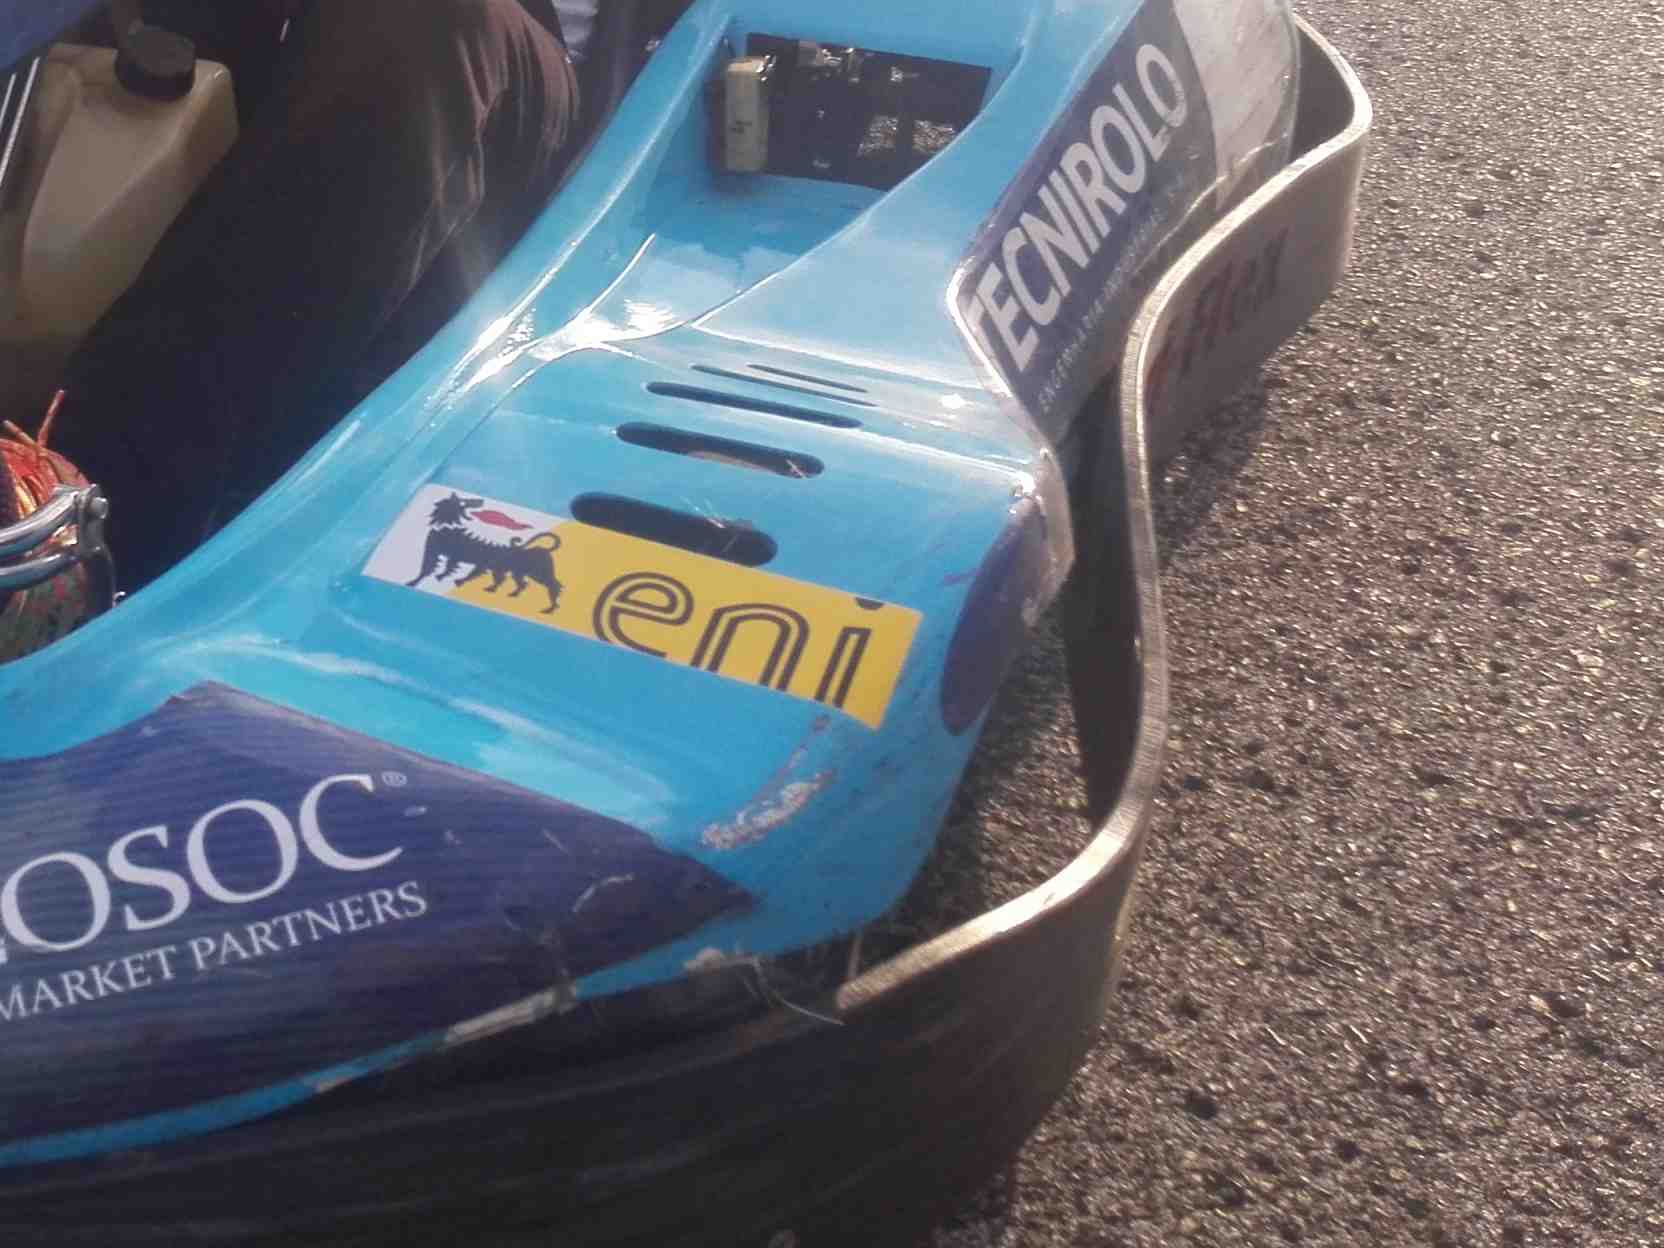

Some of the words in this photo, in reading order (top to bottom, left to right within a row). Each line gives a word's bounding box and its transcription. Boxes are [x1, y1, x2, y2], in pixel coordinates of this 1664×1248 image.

[966, 43, 1188, 380] TECNIROLO
[592, 571, 885, 709] eni
[188, 880, 429, 972] PARTNERS
